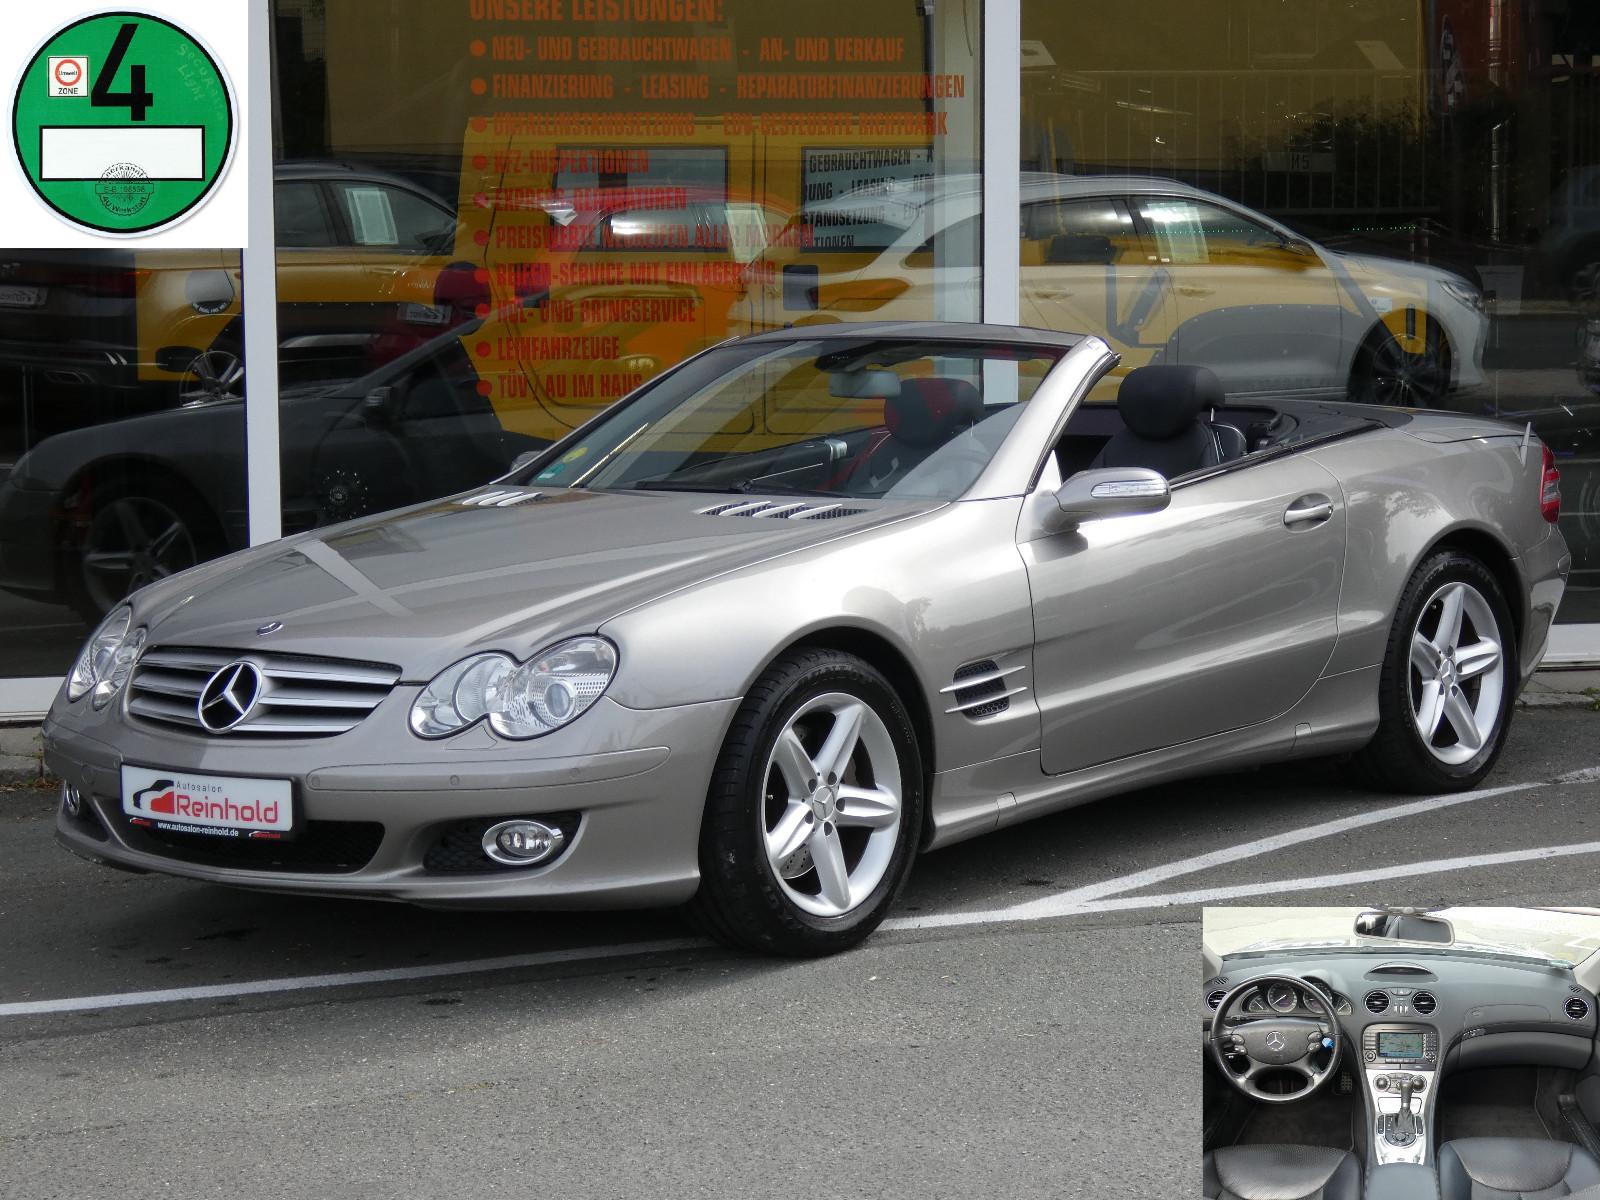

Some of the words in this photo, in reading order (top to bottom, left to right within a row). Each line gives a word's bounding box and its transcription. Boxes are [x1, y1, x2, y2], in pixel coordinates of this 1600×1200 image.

[469, 0, 563, 20] UNSERE
[572, 0, 723, 22] LEISTUNGEN!
[492, 36, 531, 61] NEU-
[538, 36, 572, 61] UND
[578, 36, 731, 62] GEBRAUCHTWAGEN
[760, 37, 789, 61] AN-
[796, 37, 829, 61] UND
[835, 37, 904, 61] VERKAUF
[492, 74, 613, 98] FINANZIERUNG
[641, 74, 709, 98] LEASING
[736, 74, 965, 98] REPARATURFINANZIERUNGEN
[495, 150, 649, 174] KFZ-INSPEKTIONEN
[810, 149, 910, 173] GEBRAUCHTWAGEN
[496, 225, 596, 249] PREISWERTE
[629, 263, 659, 285] MIT
[541, 300, 574, 322] UND
[581, 299, 695, 322] BRINGSERVICE
[498, 336, 619, 360] LEIHFAHRZEUGE
[498, 369, 527, 398] TÜV
[546, 374, 567, 397] AU
[573, 374, 594, 397] IM
[176, 781, 222, 793] Autosalon
[176, 796, 278, 824] Reinhold
[157, 821, 239, 837] www.autosalon-reinhold.de
